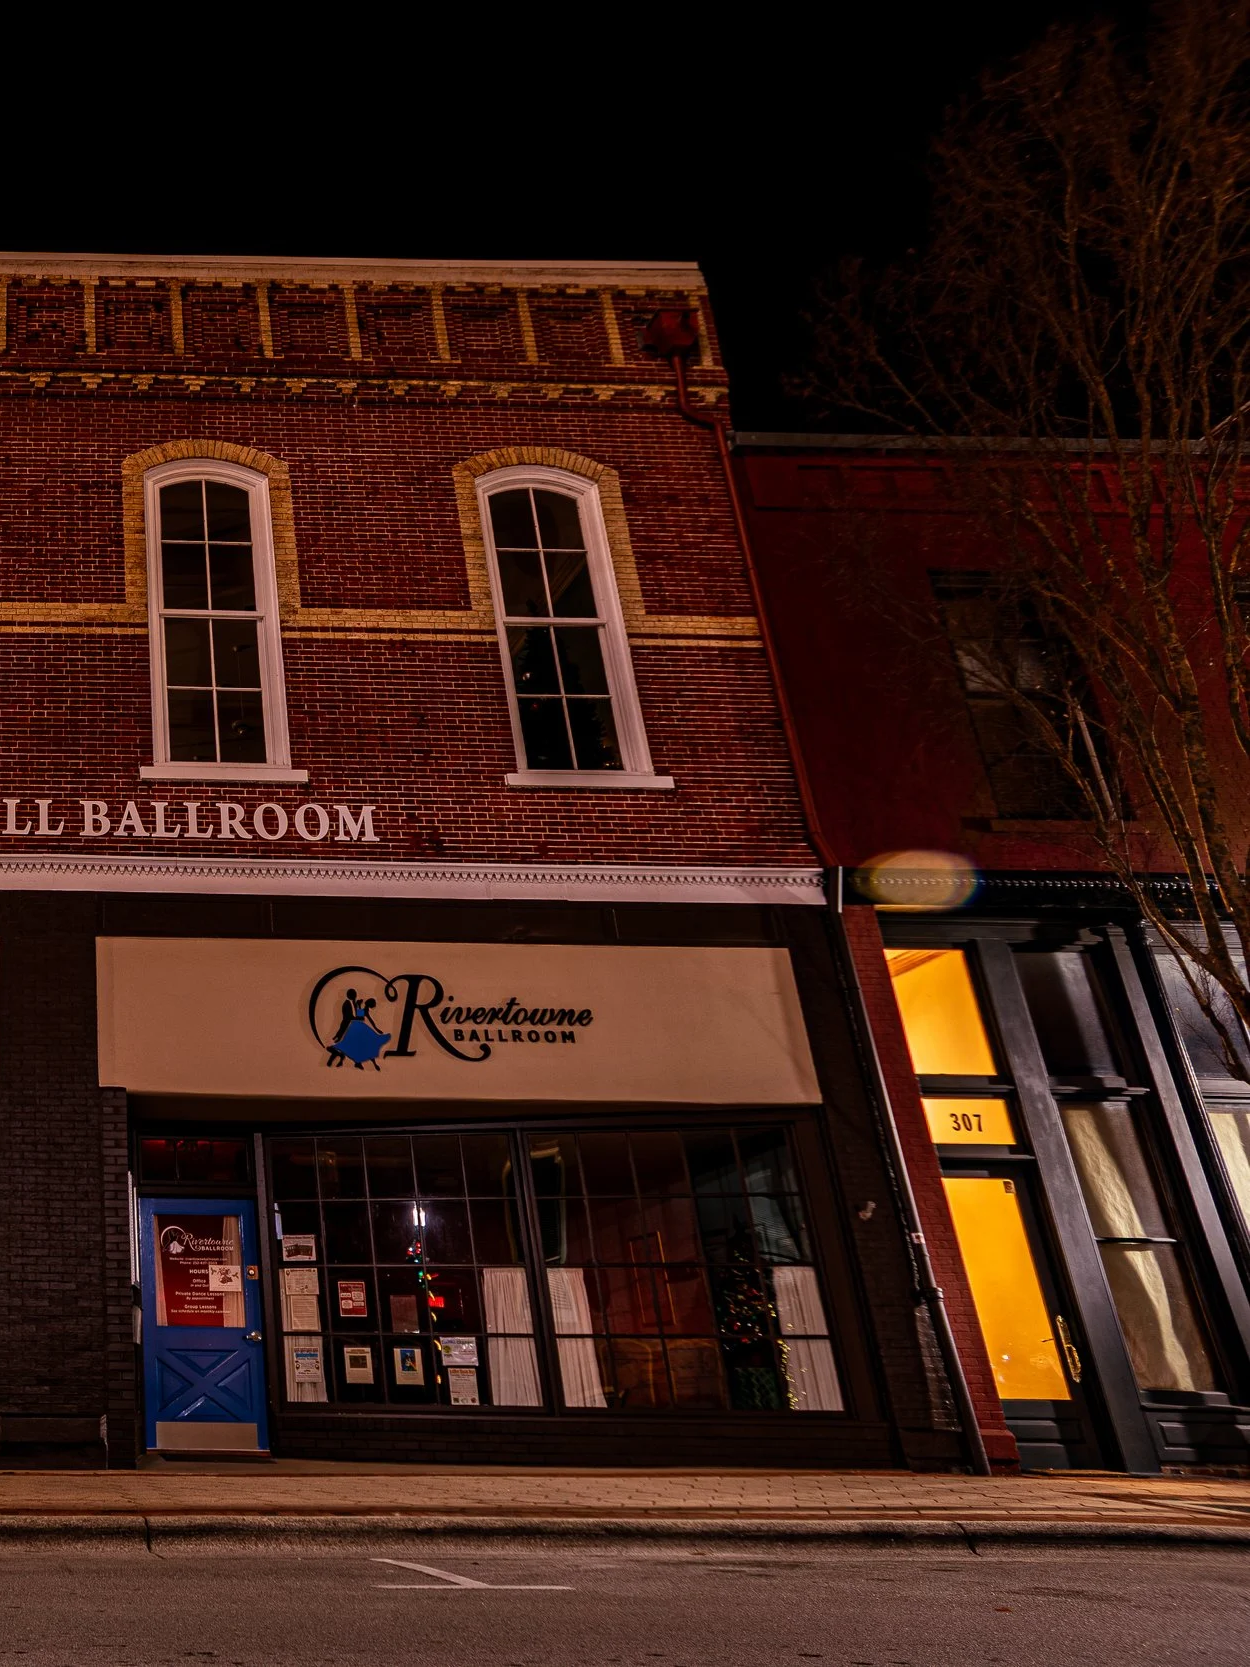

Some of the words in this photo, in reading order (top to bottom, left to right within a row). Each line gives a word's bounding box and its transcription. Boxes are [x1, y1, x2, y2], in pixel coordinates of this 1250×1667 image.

[79, 800, 381, 842] BALLROOM
[383, 974, 594, 1062] Rivertowne
[453, 1029, 576, 1043] BALLROOM
[949, 1113, 983, 1132] 307
